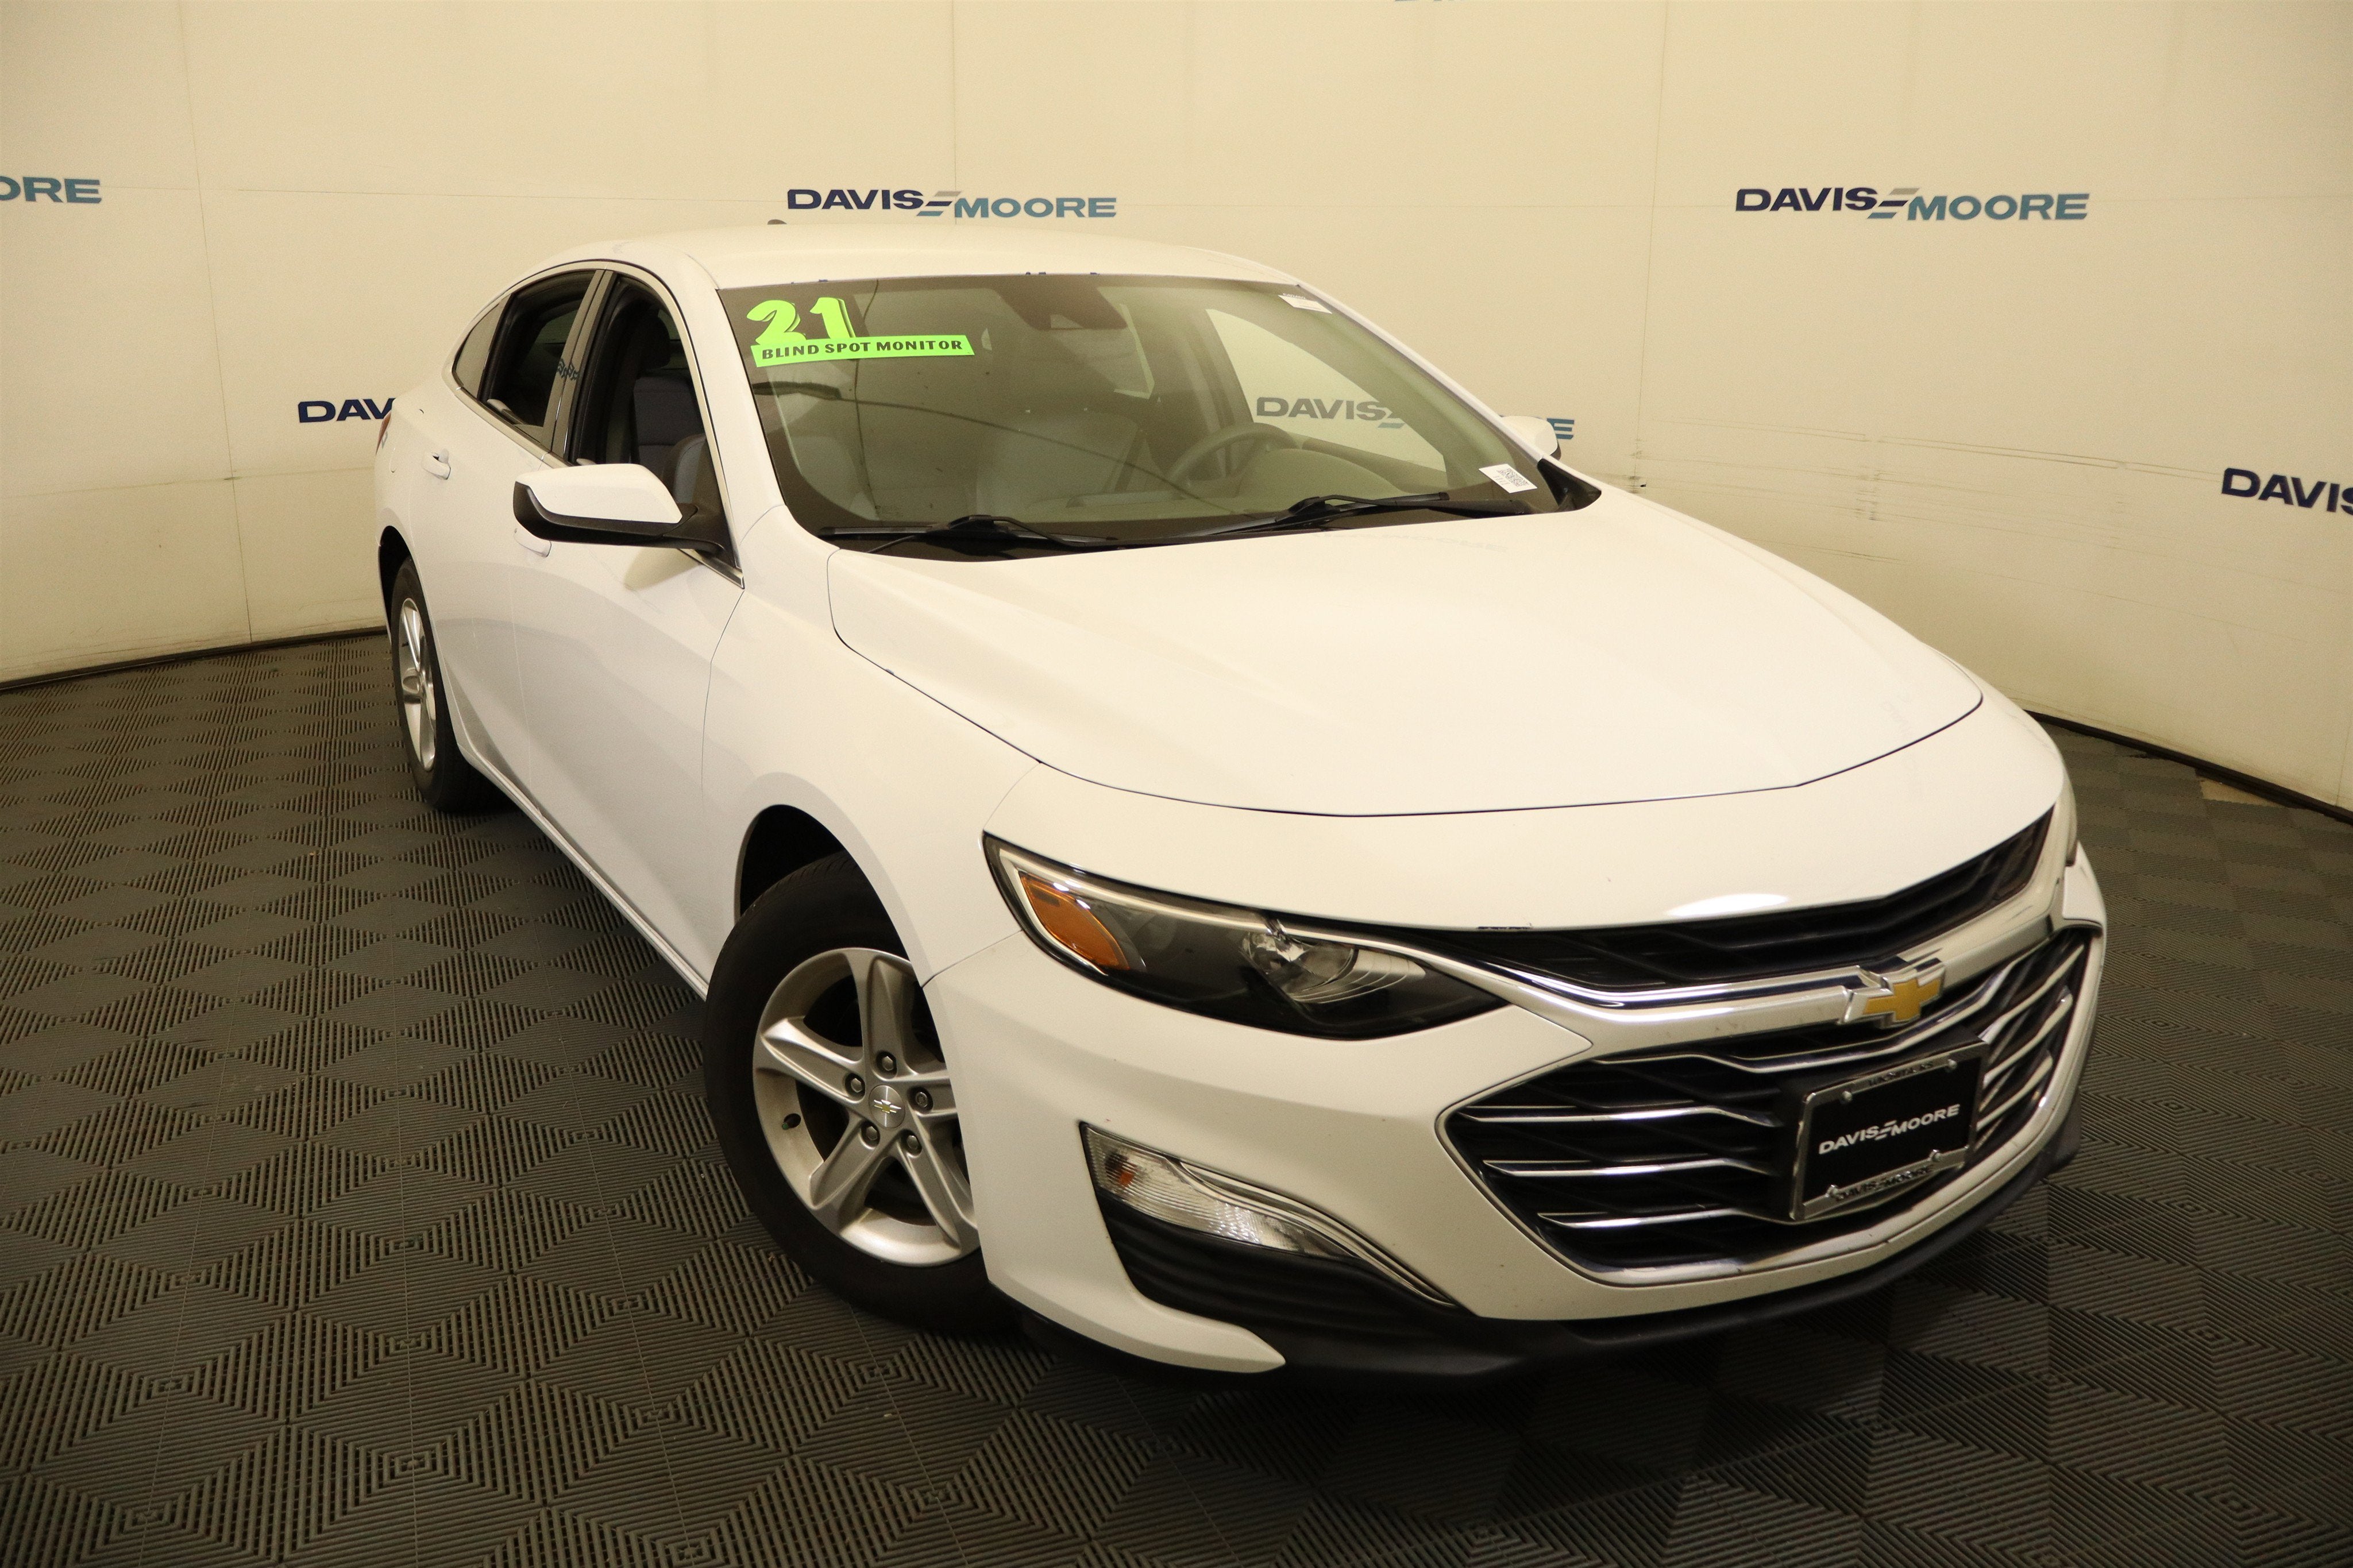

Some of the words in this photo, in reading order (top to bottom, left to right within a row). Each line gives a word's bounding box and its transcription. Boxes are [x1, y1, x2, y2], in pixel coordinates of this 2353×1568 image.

[787, 189, 924, 210] DAVIS
[955, 198, 1117, 218] MOORE
[1735, 187, 1878, 212] DAVIS
[1907, 194, 2089, 221] MOORE
[747, 297, 856, 345] 21
[762, 345, 819, 360] BLIND
[825, 342, 871, 353] SPOT
[877, 340, 963, 351] MONITOR
[1256, 397, 1387, 421] DAVIS
[1819, 1125, 1879, 1154] DAVIS
[1891, 1103, 1961, 1136] MOORE
